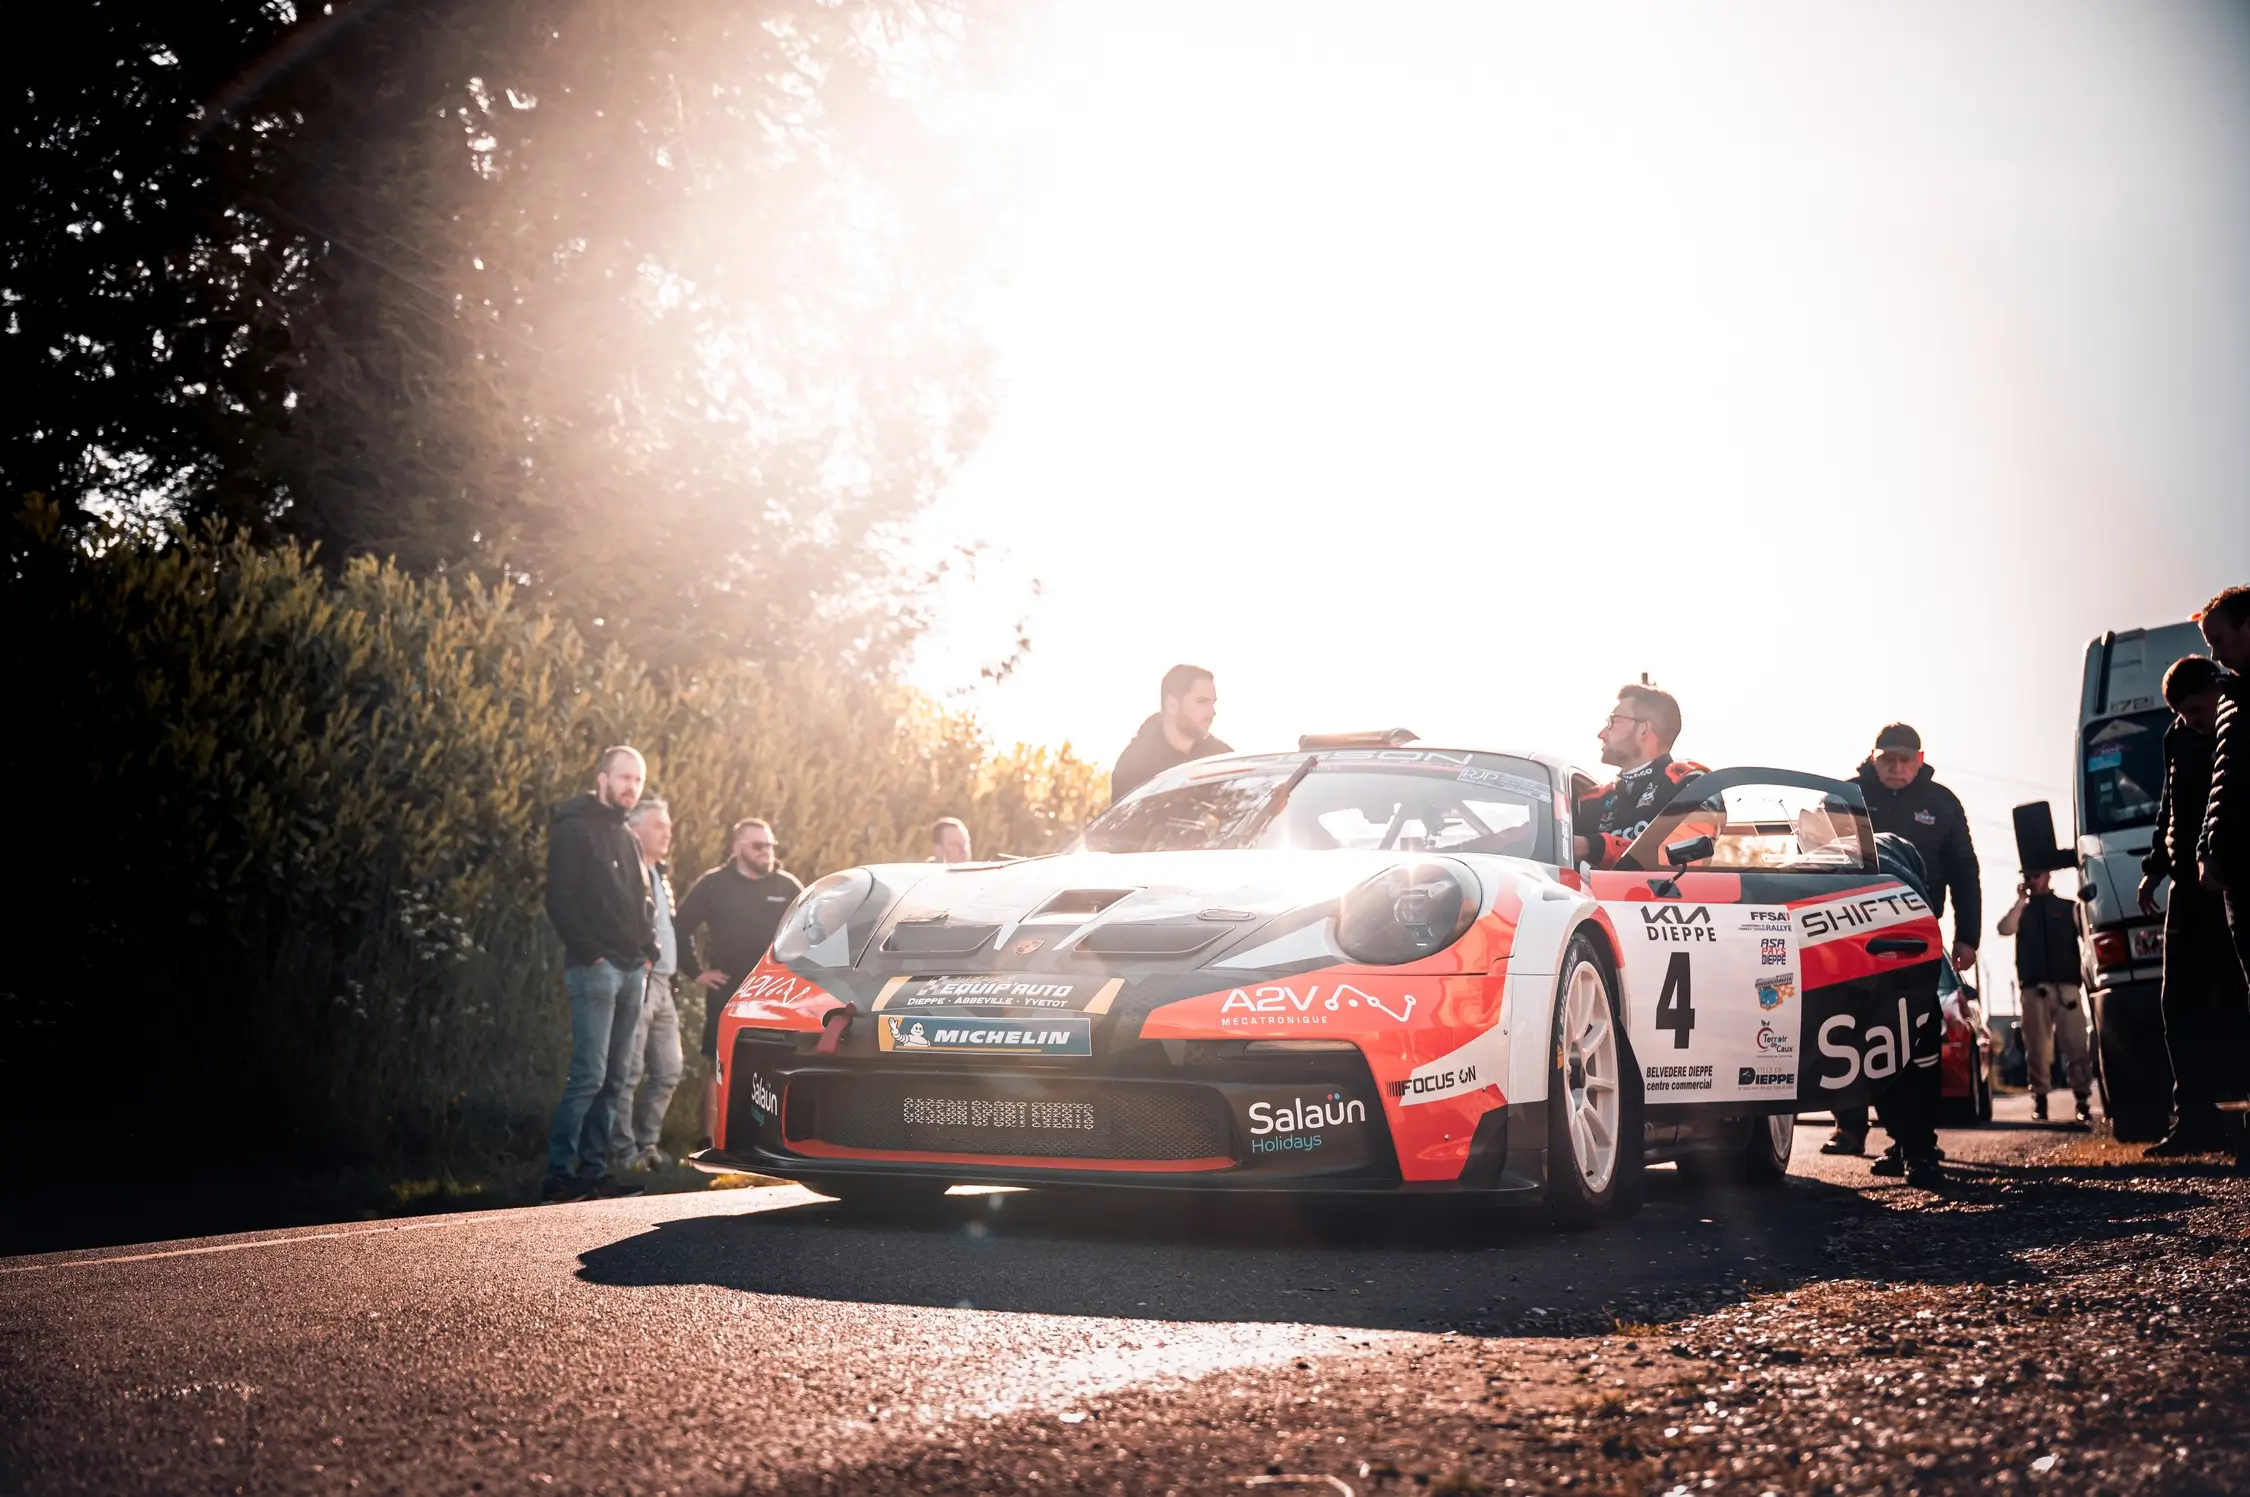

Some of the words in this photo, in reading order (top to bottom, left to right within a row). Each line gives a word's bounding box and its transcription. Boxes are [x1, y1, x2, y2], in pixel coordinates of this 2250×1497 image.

[1463, 766, 1498, 782] RJP
[1750, 911, 1787, 921] FFSA
[1646, 926, 1717, 942] DIEPPE
[1765, 924, 1792, 932] RALLYE
[1761, 938, 1785, 948] ASA
[1762, 947, 1787, 955] PAYS
[1762, 954, 1787, 966] DIEPPE
[940, 981, 1074, 998] EQUIP'AUTO
[907, 997, 945, 1006] DIEPPE
[954, 997, 1012, 1006] ABBEVILLE
[1025, 998, 1069, 1008] YVETOT
[1221, 985, 1319, 1013] A2V
[1656, 952, 1696, 1049] 4
[1221, 1015, 1328, 1026] MECATRONIQUE
[934, 1029, 1071, 1045] MICHELIN
[1763, 1033, 1788, 1043] Terroir
[1818, 998, 1930, 1090] Sal
[1646, 1067, 1687, 1078] BELVEDERE
[1688, 1066, 1713, 1077] DIEPPE
[1739, 1067, 1795, 1086] DIEPPE
[1401, 1071, 1455, 1097] FOCUS
[1646, 1080, 1670, 1091] centre
[1671, 1079, 1713, 1090] commercial
[1248, 1092, 1366, 1135] Salaün
[1252, 1134, 1322, 1153] Holidays
